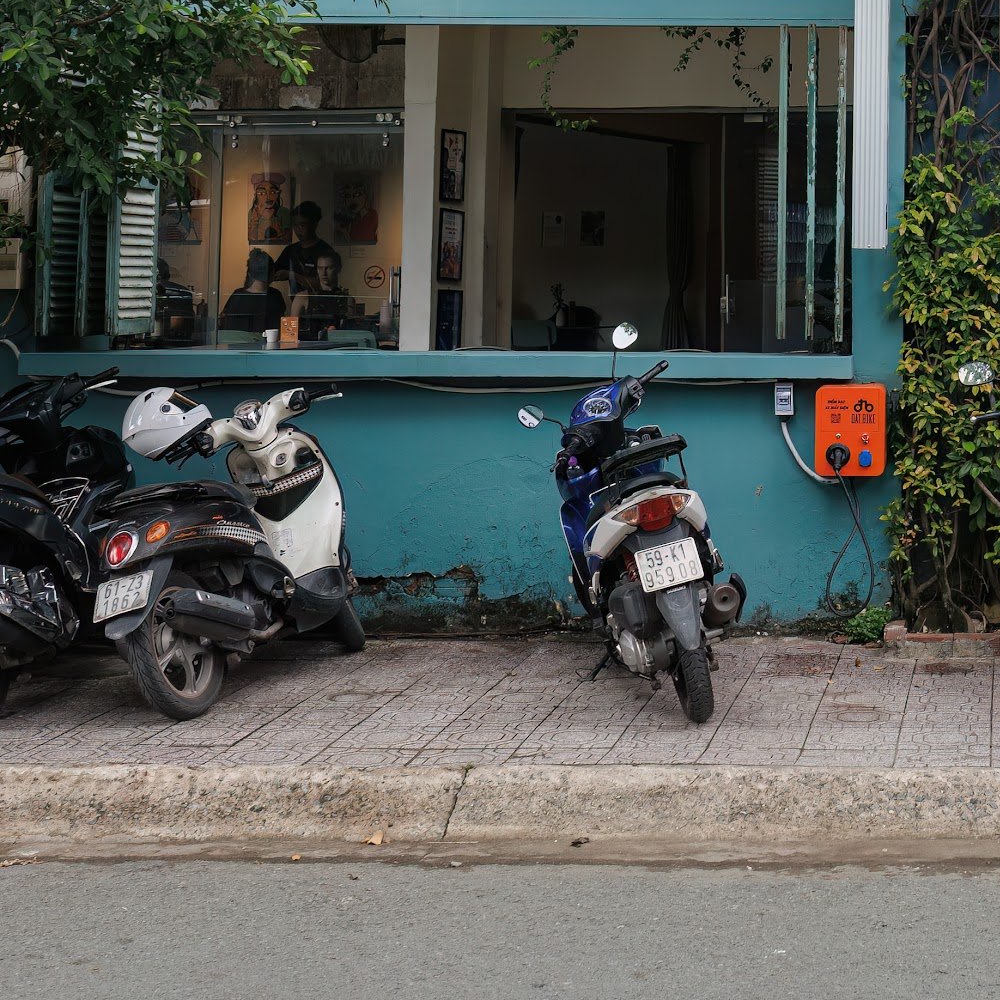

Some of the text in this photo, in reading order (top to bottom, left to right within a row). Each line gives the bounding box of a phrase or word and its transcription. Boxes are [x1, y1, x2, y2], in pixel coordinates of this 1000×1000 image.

[862, 413, 876, 424] BIKE
[645, 543, 686, 569] 59-K1
[104, 574, 144, 599] 61-Z3
